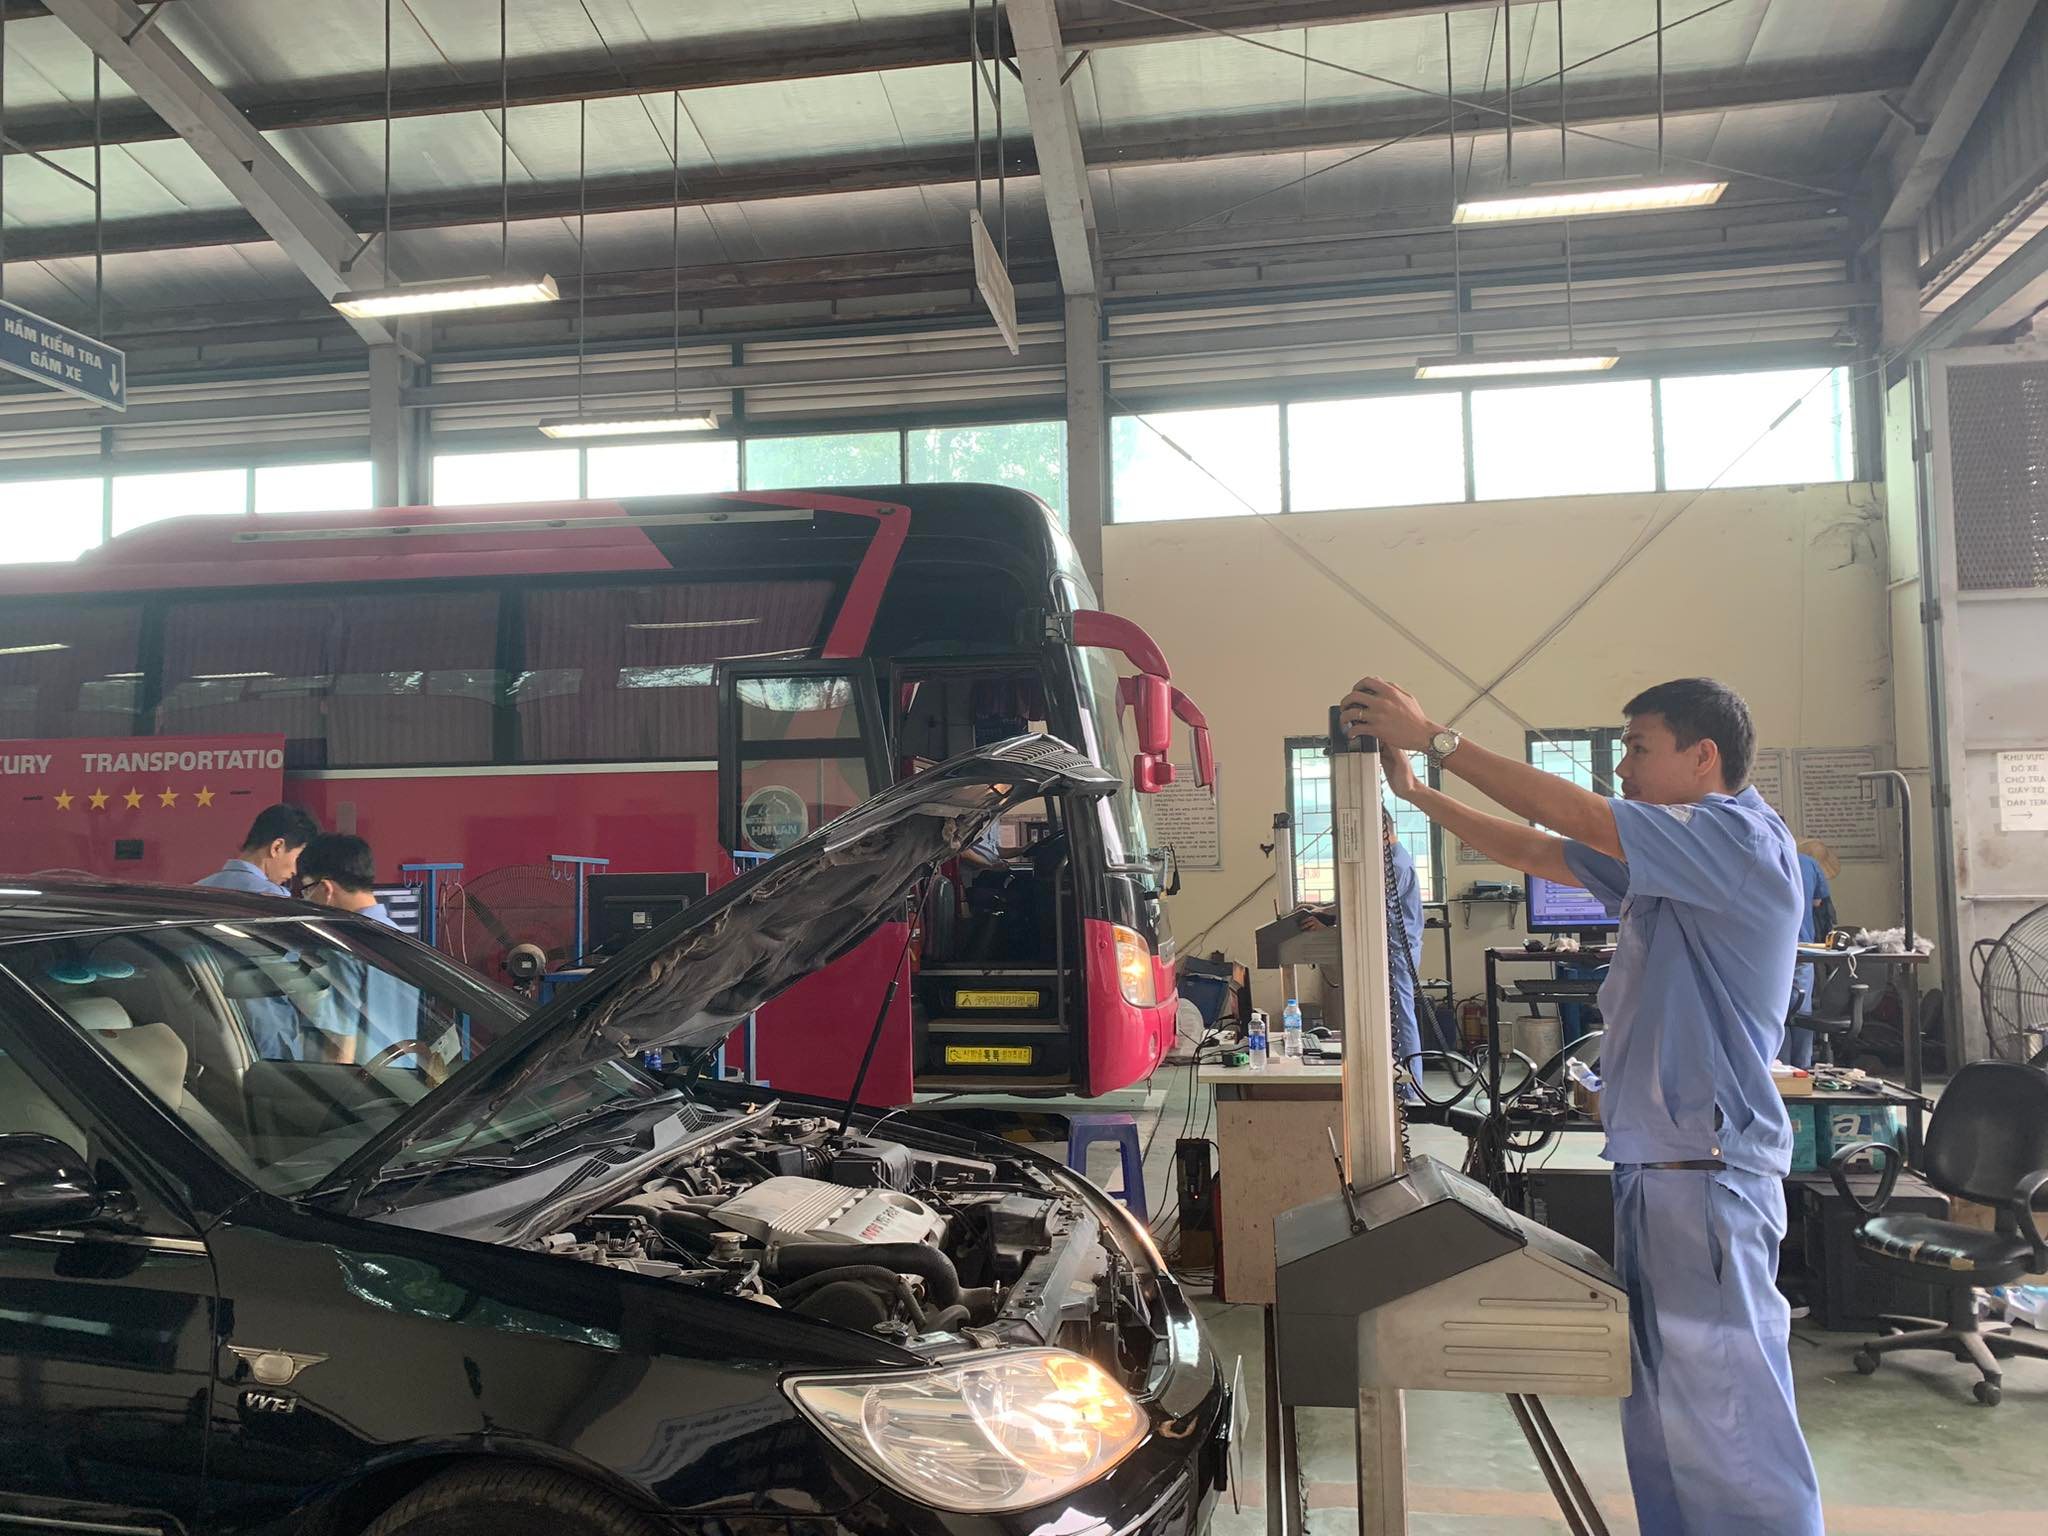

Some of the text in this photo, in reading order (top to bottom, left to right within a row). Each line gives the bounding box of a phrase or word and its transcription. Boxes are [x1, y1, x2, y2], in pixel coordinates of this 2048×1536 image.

[78, 348, 103, 369] TRA
[65, 365, 83, 382] XE
[0, 754, 52, 775] URY
